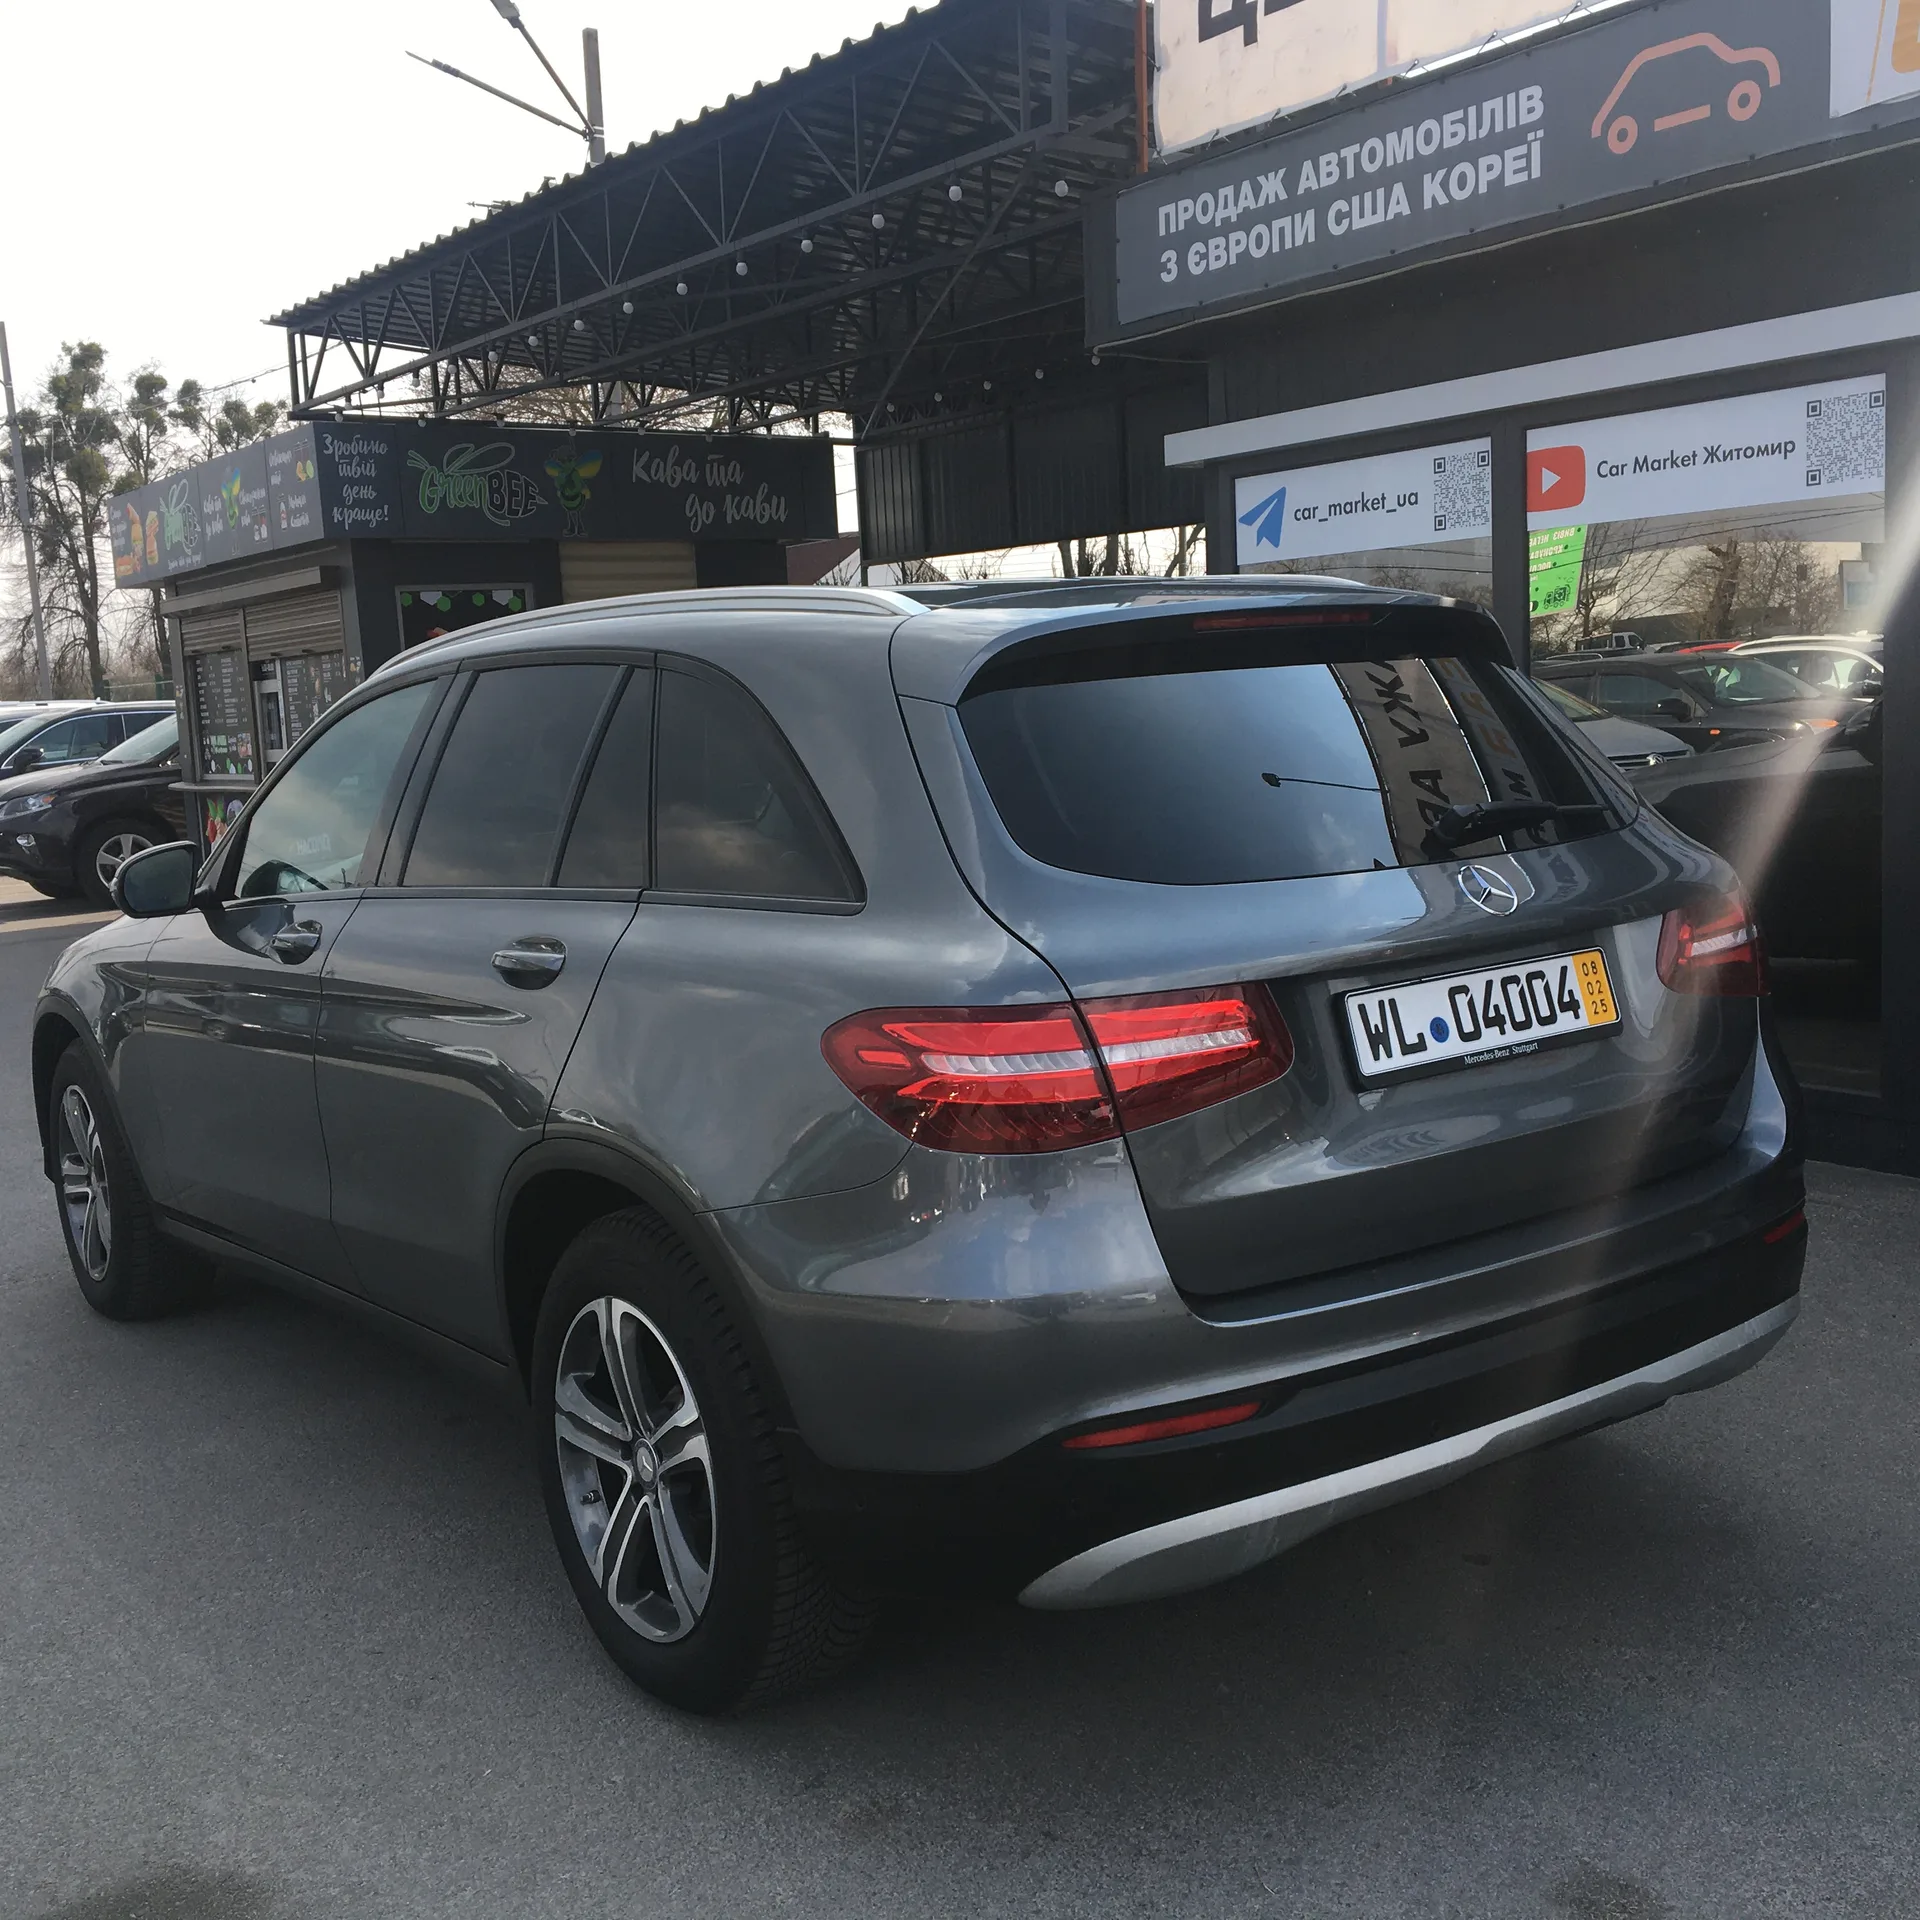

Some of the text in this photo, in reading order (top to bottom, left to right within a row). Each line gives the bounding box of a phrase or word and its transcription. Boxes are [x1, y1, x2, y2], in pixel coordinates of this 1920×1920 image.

[1158, 84, 1545, 237] ПРОДАЖ АВТОМОБІЛІВ
[1160, 128, 1545, 283] З ЄВРОПИ США КОРЕЇ
[322, 433, 388, 462] Зробимо
[1596, 439, 1797, 478] Car Market Житомир
[338, 455, 378, 478] твій
[632, 444, 744, 488] Кава та
[342, 483, 378, 505] день
[685, 482, 788, 533] до кави
[1293, 491, 1419, 522] car_market_ua
[331, 504, 389, 530] краще!
[1581, 961, 1598, 976] 08
[1586, 980, 1603, 995] 02
[1357, 965, 1581, 1061] WL 04004
[1591, 999, 1608, 1015] 25
[1464, 1042, 1539, 1065] Mercedes-Benz Stuttgart
